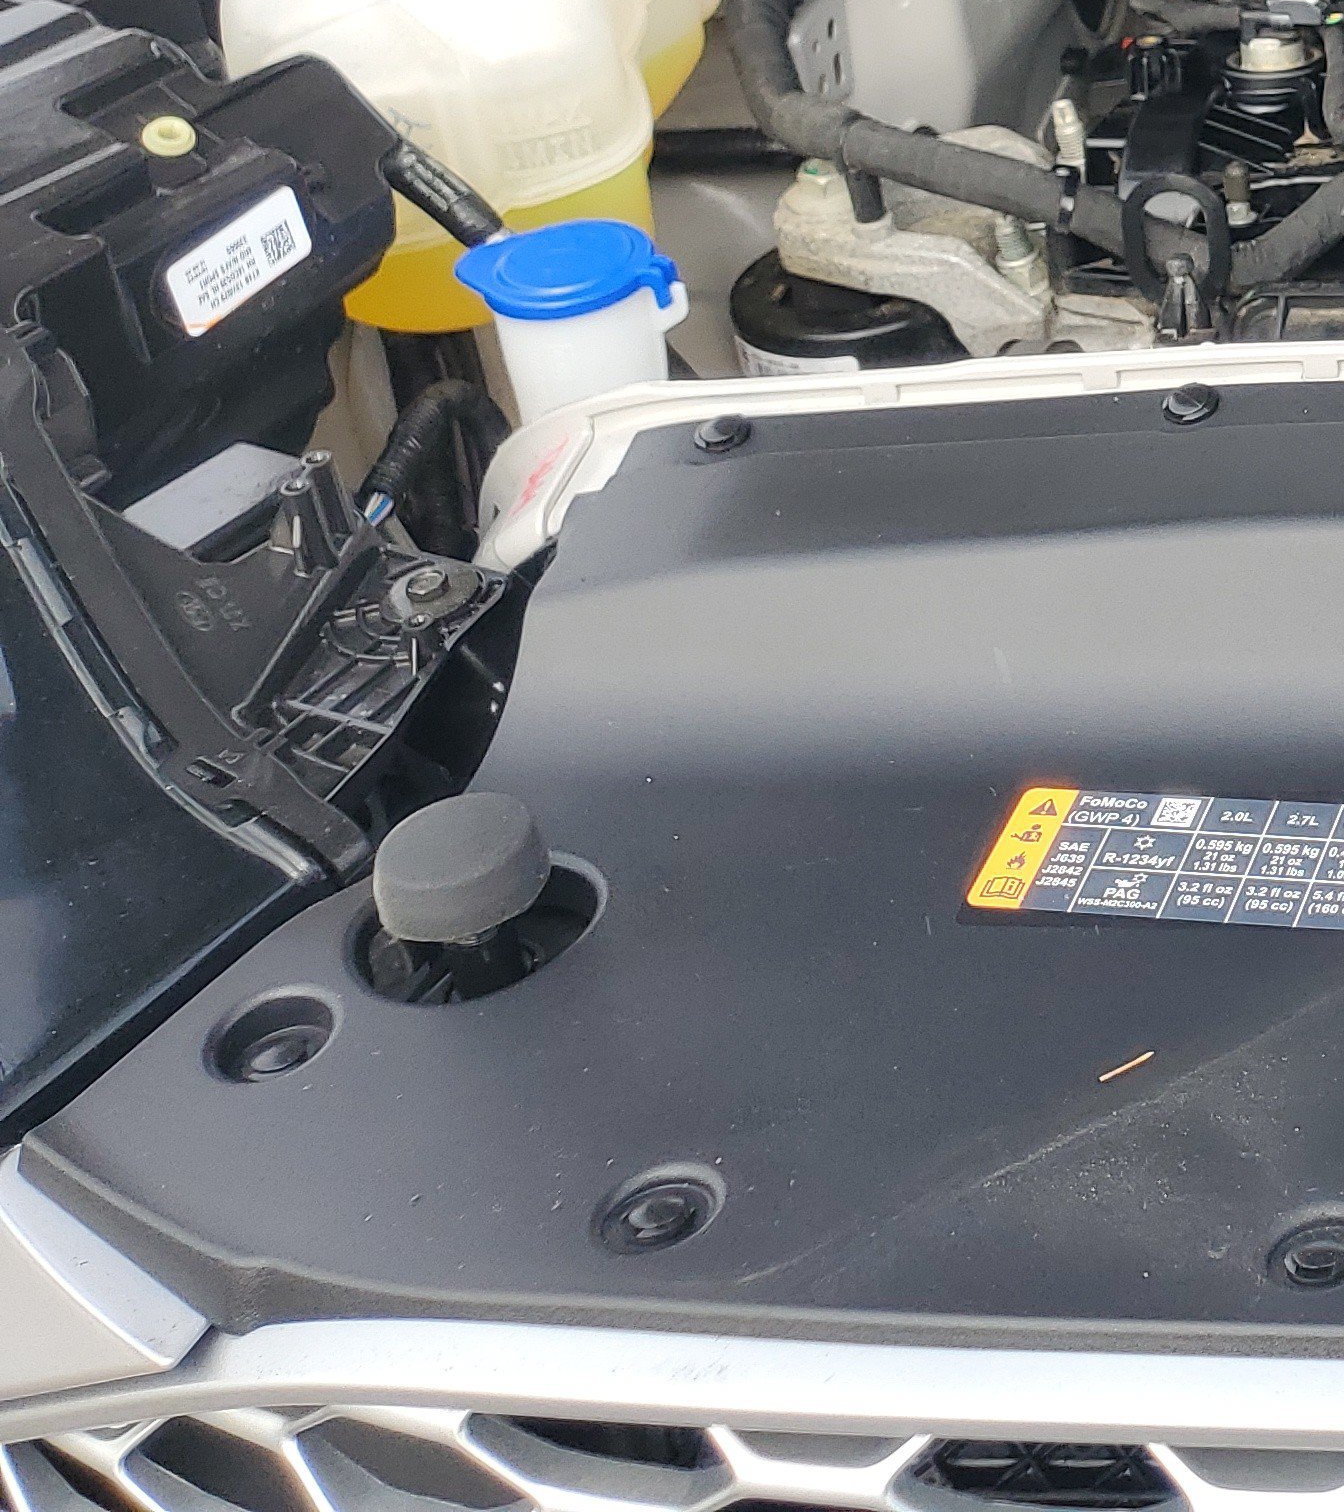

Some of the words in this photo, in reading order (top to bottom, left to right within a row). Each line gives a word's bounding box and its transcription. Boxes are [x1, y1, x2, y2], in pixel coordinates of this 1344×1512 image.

[1079, 795, 1148, 809] FoMoCo
[1068, 811, 1120, 824] (GWP
[1123, 813, 1140, 826] 4)
[1220, 811, 1253, 822] 2.0L
[1286, 814, 1319, 826] 2.7L
[1058, 841, 1090, 852] SAE
[1195, 839, 1233, 851] 0.595
[1234, 841, 1254, 855] kg
[1262, 843, 1300, 855] 0.595
[1302, 845, 1321, 859] kg
[1050, 853, 1085, 863] J639
[1102, 853, 1175, 868] R-1234yf
[1202, 851, 1218, 861] 21
[1220, 854, 1236, 862] oz
[1270, 856, 1285, 865] 21
[1287, 858, 1303, 866] oz
[1041, 864, 1083, 876] J2842
[1193, 861, 1217, 872] 1.31
[1218, 863, 1237, 873] lbs
[1260, 865, 1284, 876] 1.31
[1285, 867, 1305, 877] lbs
[1035, 876, 1077, 887] J2845
[1103, 888, 1141, 899] PAG
[1177, 882, 1200, 892] 3.2
[1202, 883, 1213, 893] fl
[1215, 886, 1233, 895] oz
[1245, 886, 1268, 897] 3.2
[1270, 887, 1281, 898] fl
[1283, 890, 1301, 899] oz
[1176, 894, 1200, 906] (95
[1202, 897, 1225, 908] cc)
[1312, 890, 1333, 901] 5.4
[1244, 899, 1269, 911] (95
[1270, 901, 1294, 913] cc)
[1307, 902, 1339, 915] (160
